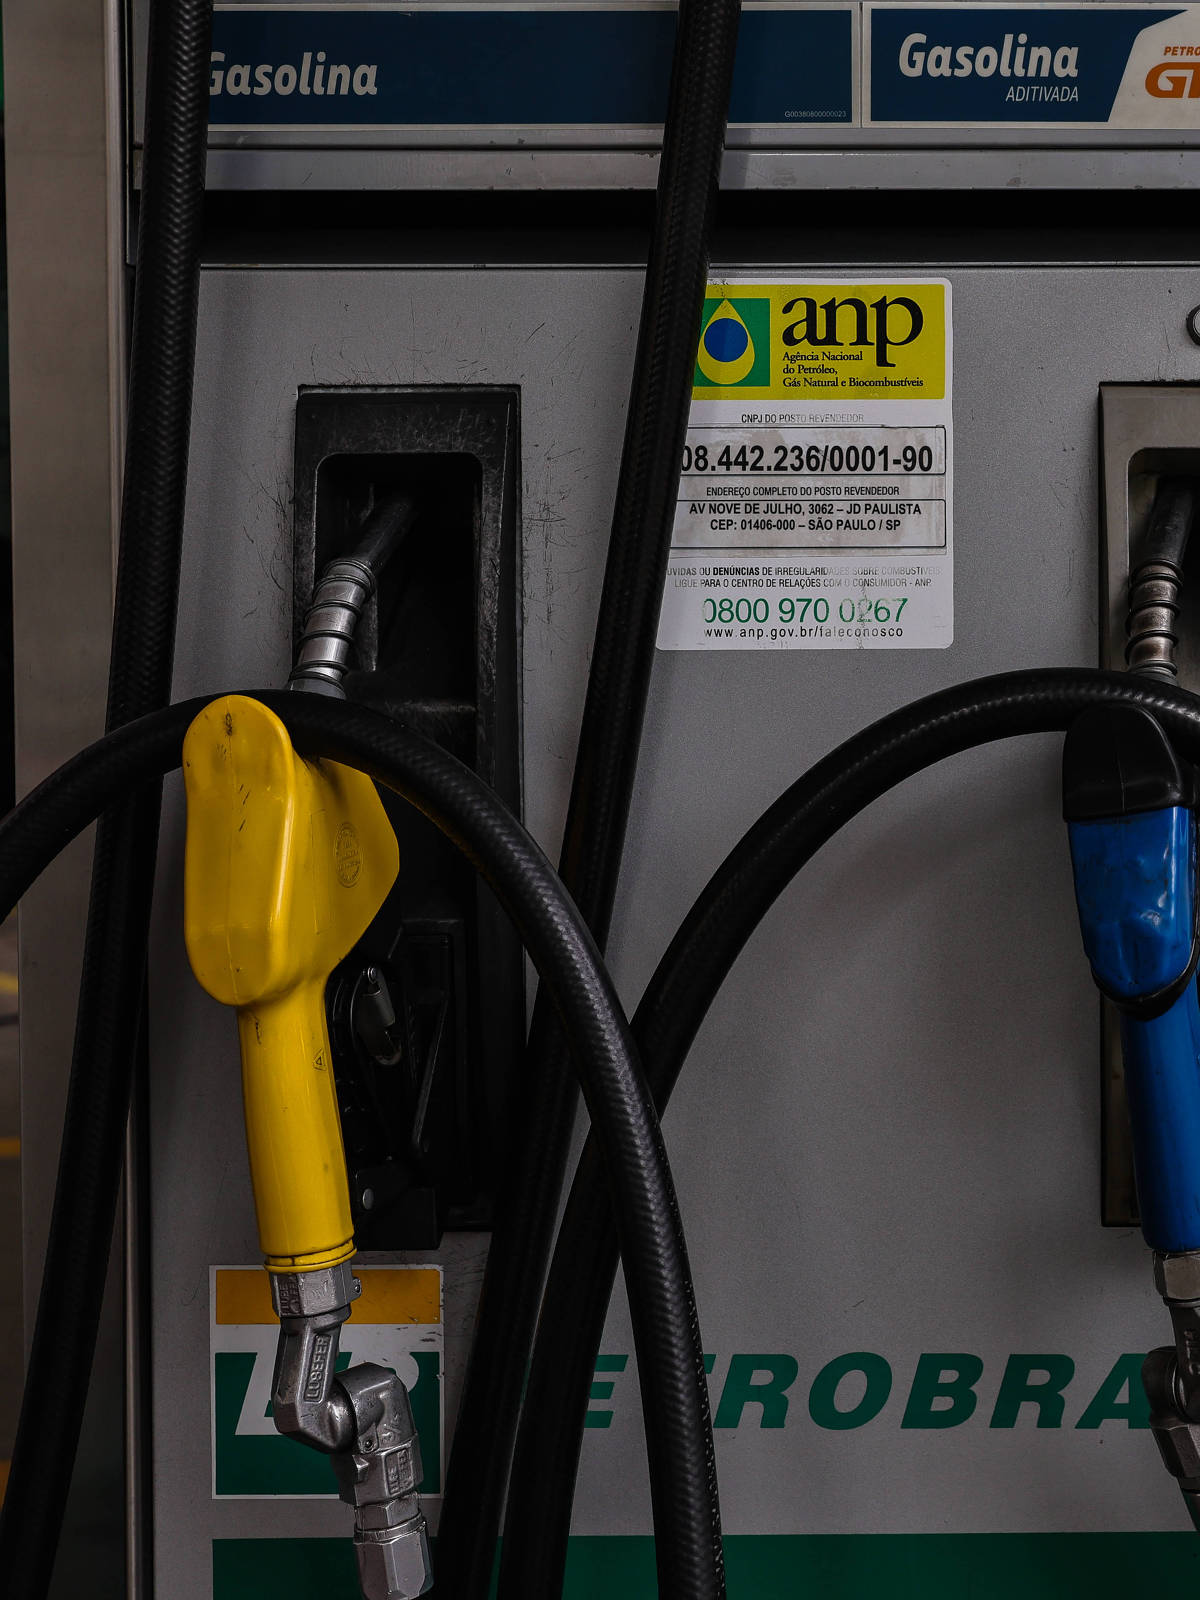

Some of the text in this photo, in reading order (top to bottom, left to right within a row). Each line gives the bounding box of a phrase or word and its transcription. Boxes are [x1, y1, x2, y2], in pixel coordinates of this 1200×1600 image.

[899, 33, 1079, 78] Gasolina
[208, 51, 378, 96] Gasolina
[1005, 86, 1079, 103] ADITIVADA
[781, 295, 924, 368] anp
[782, 351, 863, 363] Agência Nacional
[782, 364, 838, 376] do Petróleo,
[782, 377, 924, 388] Gás Natural e Biocombustíveis
[741, 414, 763, 423] CNPJ
[765, 414, 776, 423] DO
[779, 414, 807, 423] POSTO
[681, 445, 933, 472] 08.442.236/0001-90
[706, 486, 900, 498] ENDEREÇO COMPLETO DO POSTO REVENDEDOR
[689, 503, 707, 515] AV
[708, 503, 741, 515] NOVE
[743, 503, 760, 515] DE
[763, 503, 806, 517] JULHO,
[808, 503, 834, 515] 3062
[846, 503, 861, 515] JD
[863, 503, 922, 515] PAULISTA
[710, 519, 737, 531] CEP:
[740, 519, 796, 531] 01406-000
[808, 516, 834, 531] SÃO
[836, 519, 876, 531] PAULO
[885, 519, 901, 531] SP
[666, 567, 697, 576] UVIDAS
[700, 567, 711, 576] OU
[713, 565, 760, 576] DENÚNCIAS
[762, 567, 772, 576] DE
[700, 579, 721, 588] PARA
[723, 579, 729, 588] O
[731, 579, 764, 588] CENTRO
[766, 579, 776, 588] DE
[778, 577, 821, 590] RELAÇÕES
[853, 579, 907, 588] CONSUMIDOR
[914, 579, 932, 588] ANP
[702, 597, 908, 623] 0800 970 0267
